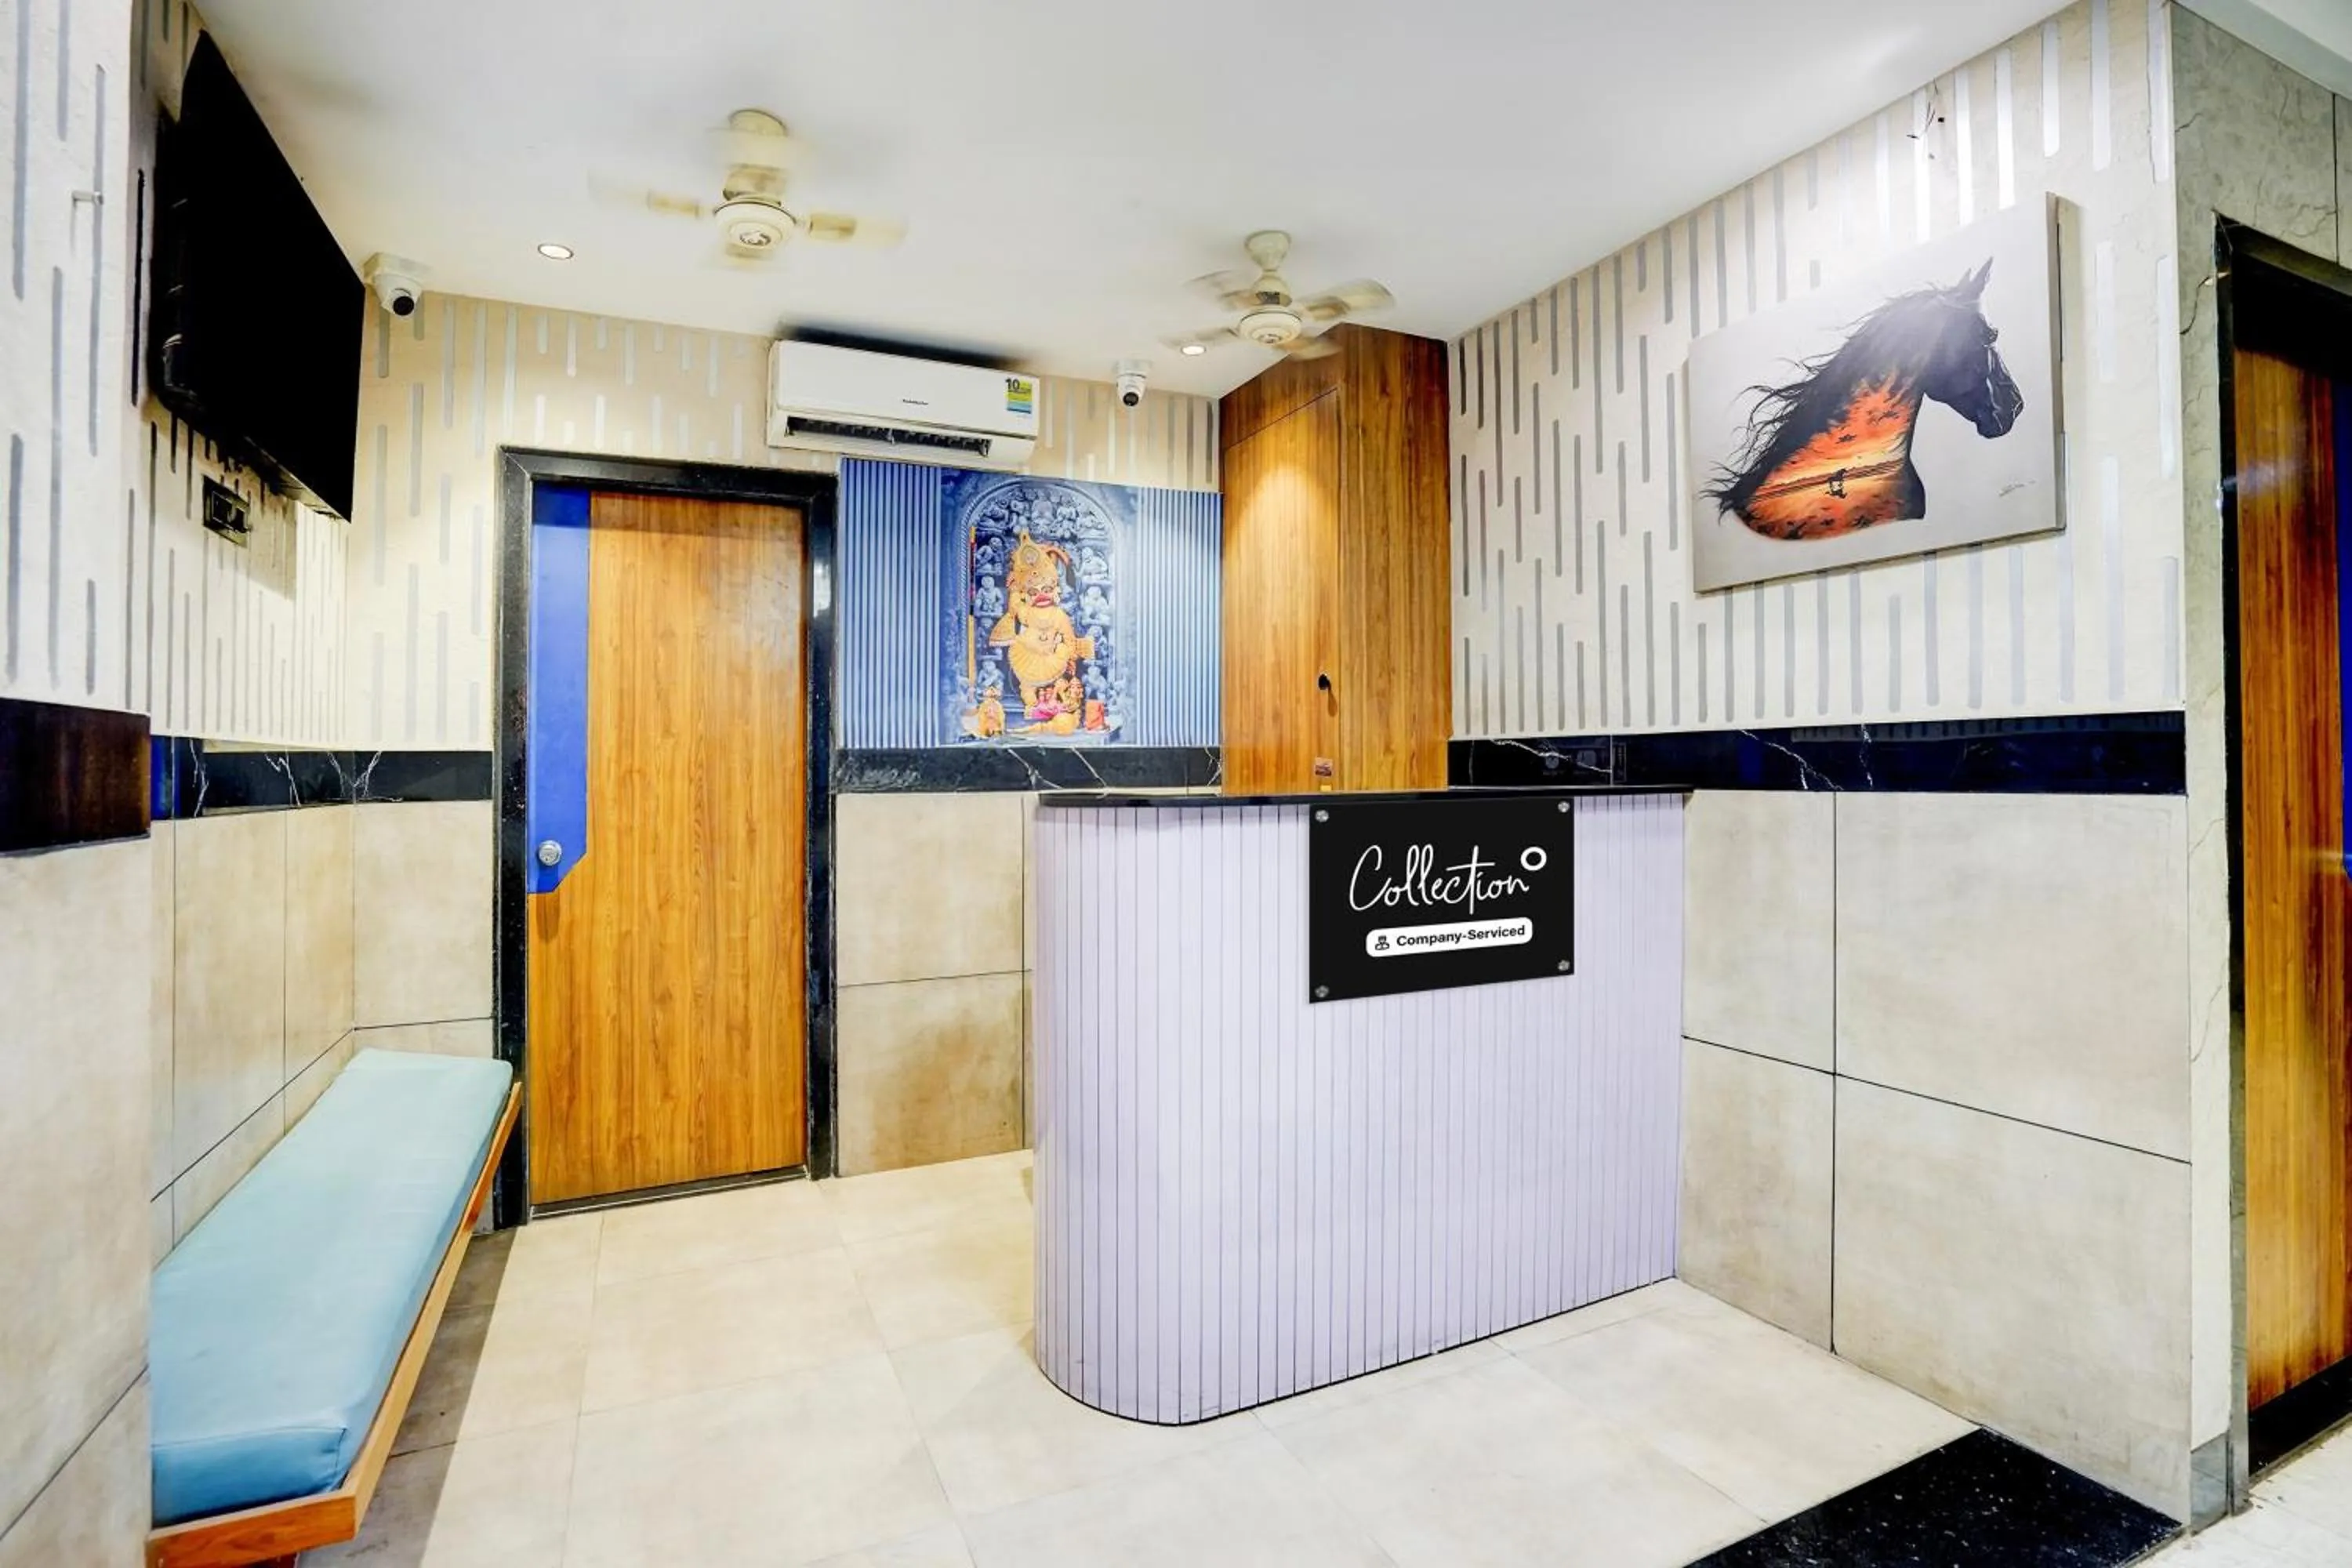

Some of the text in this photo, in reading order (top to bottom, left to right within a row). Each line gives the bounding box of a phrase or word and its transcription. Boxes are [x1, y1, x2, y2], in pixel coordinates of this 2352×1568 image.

[1005, 378, 1020, 390] 10
[1349, 844, 1530, 915] Collection
[1396, 924, 1526, 946] Company-Serviced
